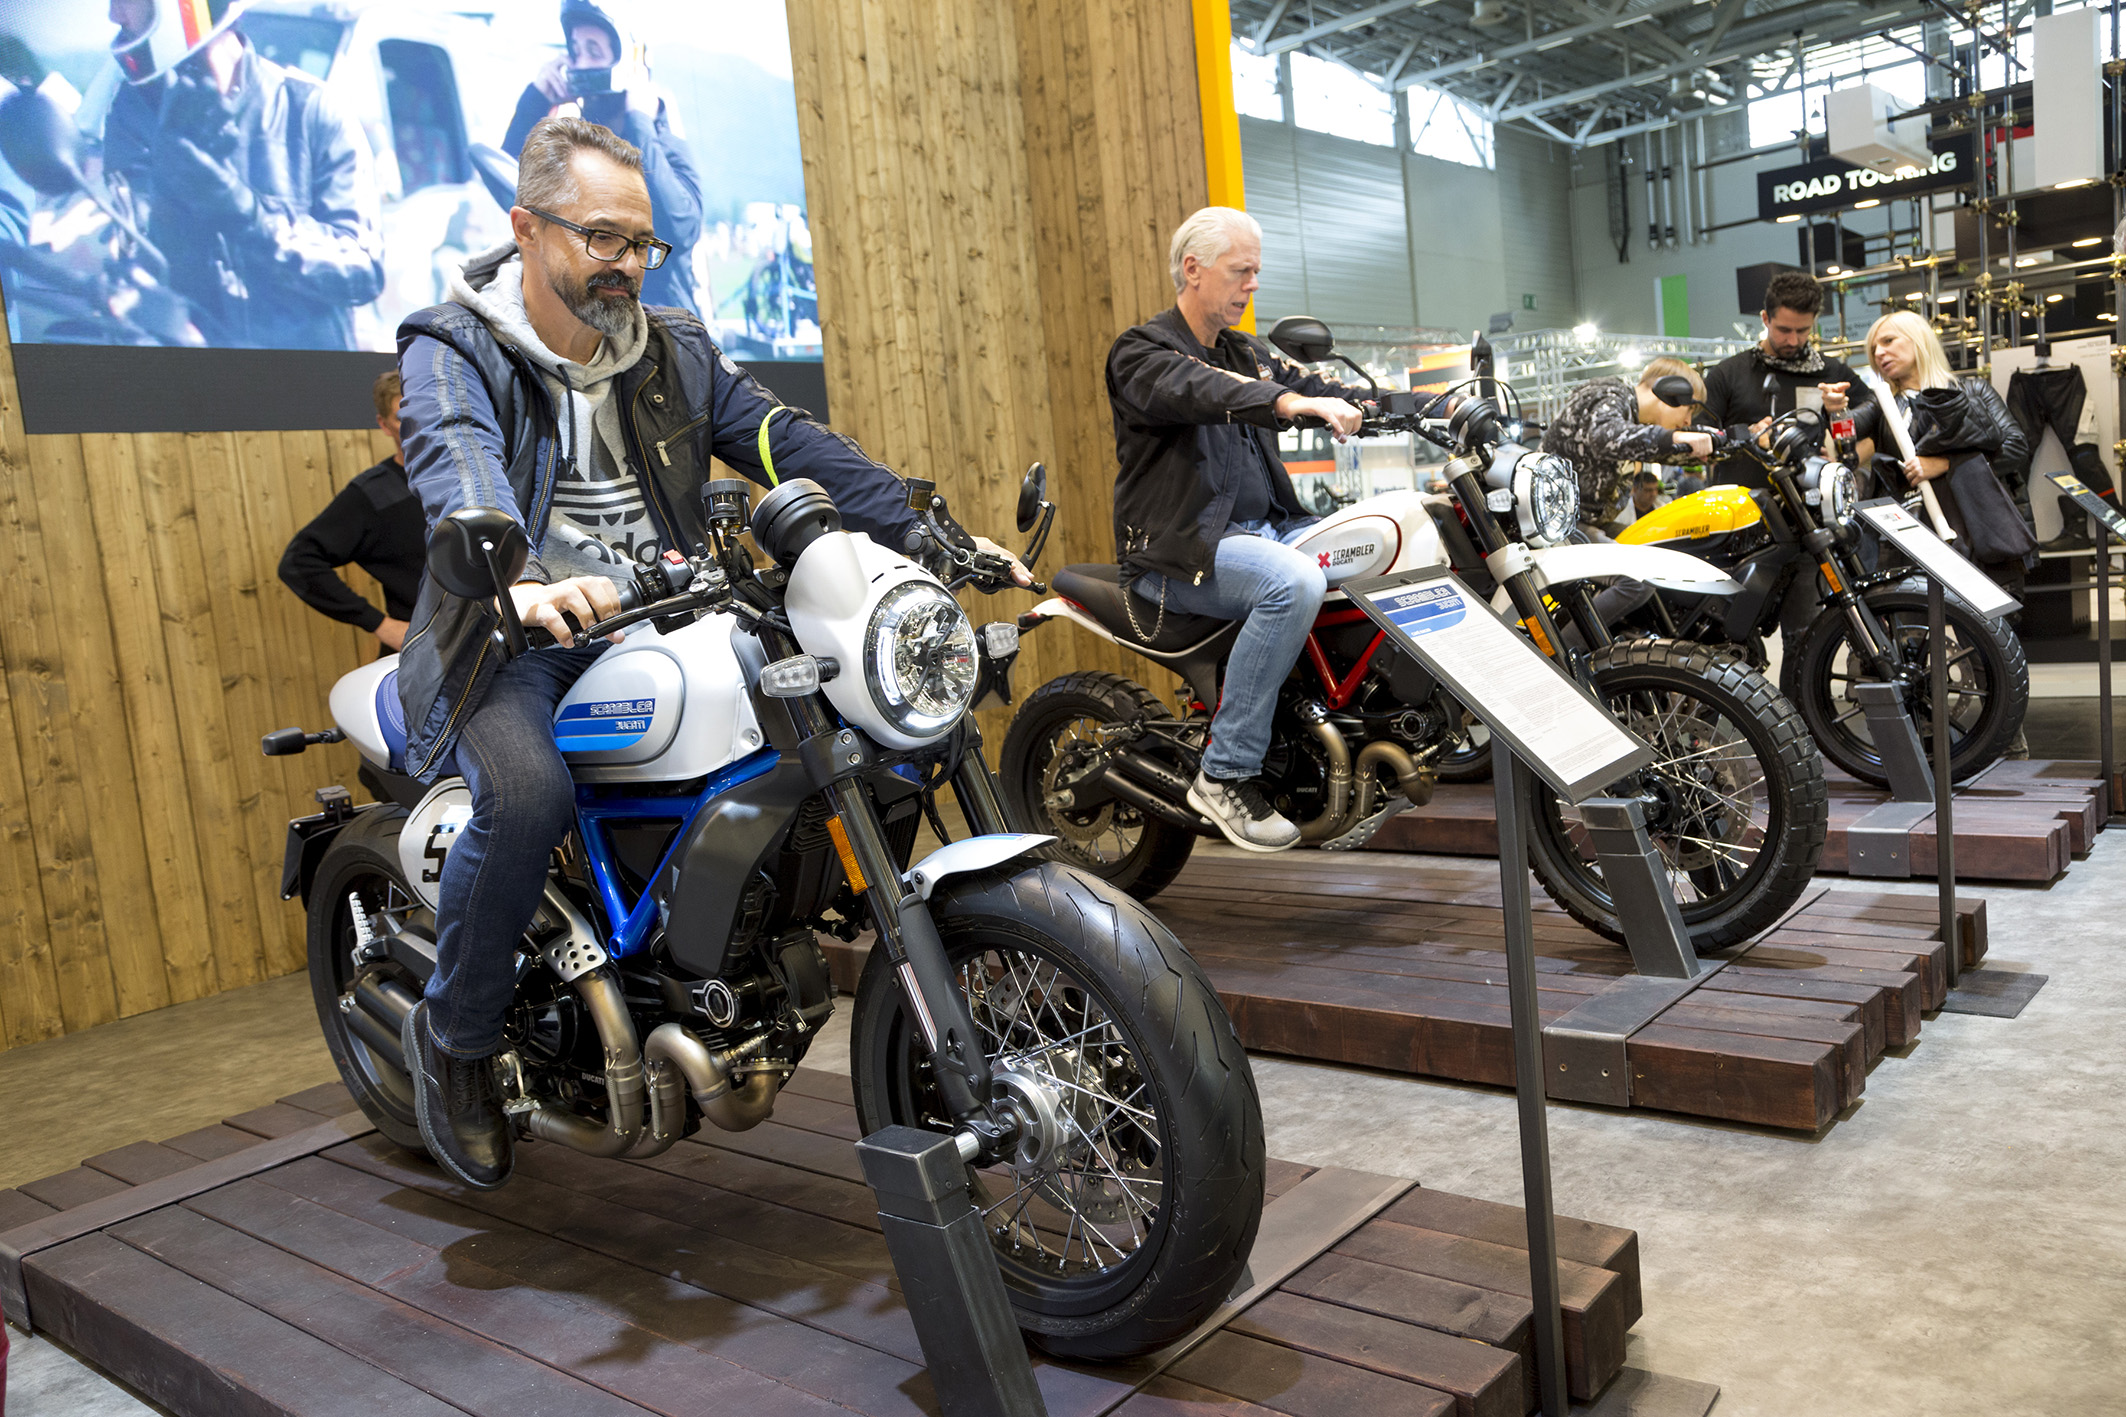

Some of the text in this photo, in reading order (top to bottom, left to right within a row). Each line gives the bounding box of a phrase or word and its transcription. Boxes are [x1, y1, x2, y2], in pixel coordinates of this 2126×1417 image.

[1773, 174, 1842, 204] ROAD
[1675, 524, 1710, 538] SCRAMBLER
[1333, 543, 1375, 561] SCRAMBLER
[1332, 557, 1354, 567] DUCATI
[1394, 586, 1452, 608] SCRAMBLER
[1434, 598, 1463, 610] DUCATI
[590, 701, 654, 717] SCRAMBLER
[615, 720, 646, 731] DUCATI
[581, 1072, 605, 1086] DUCATI
